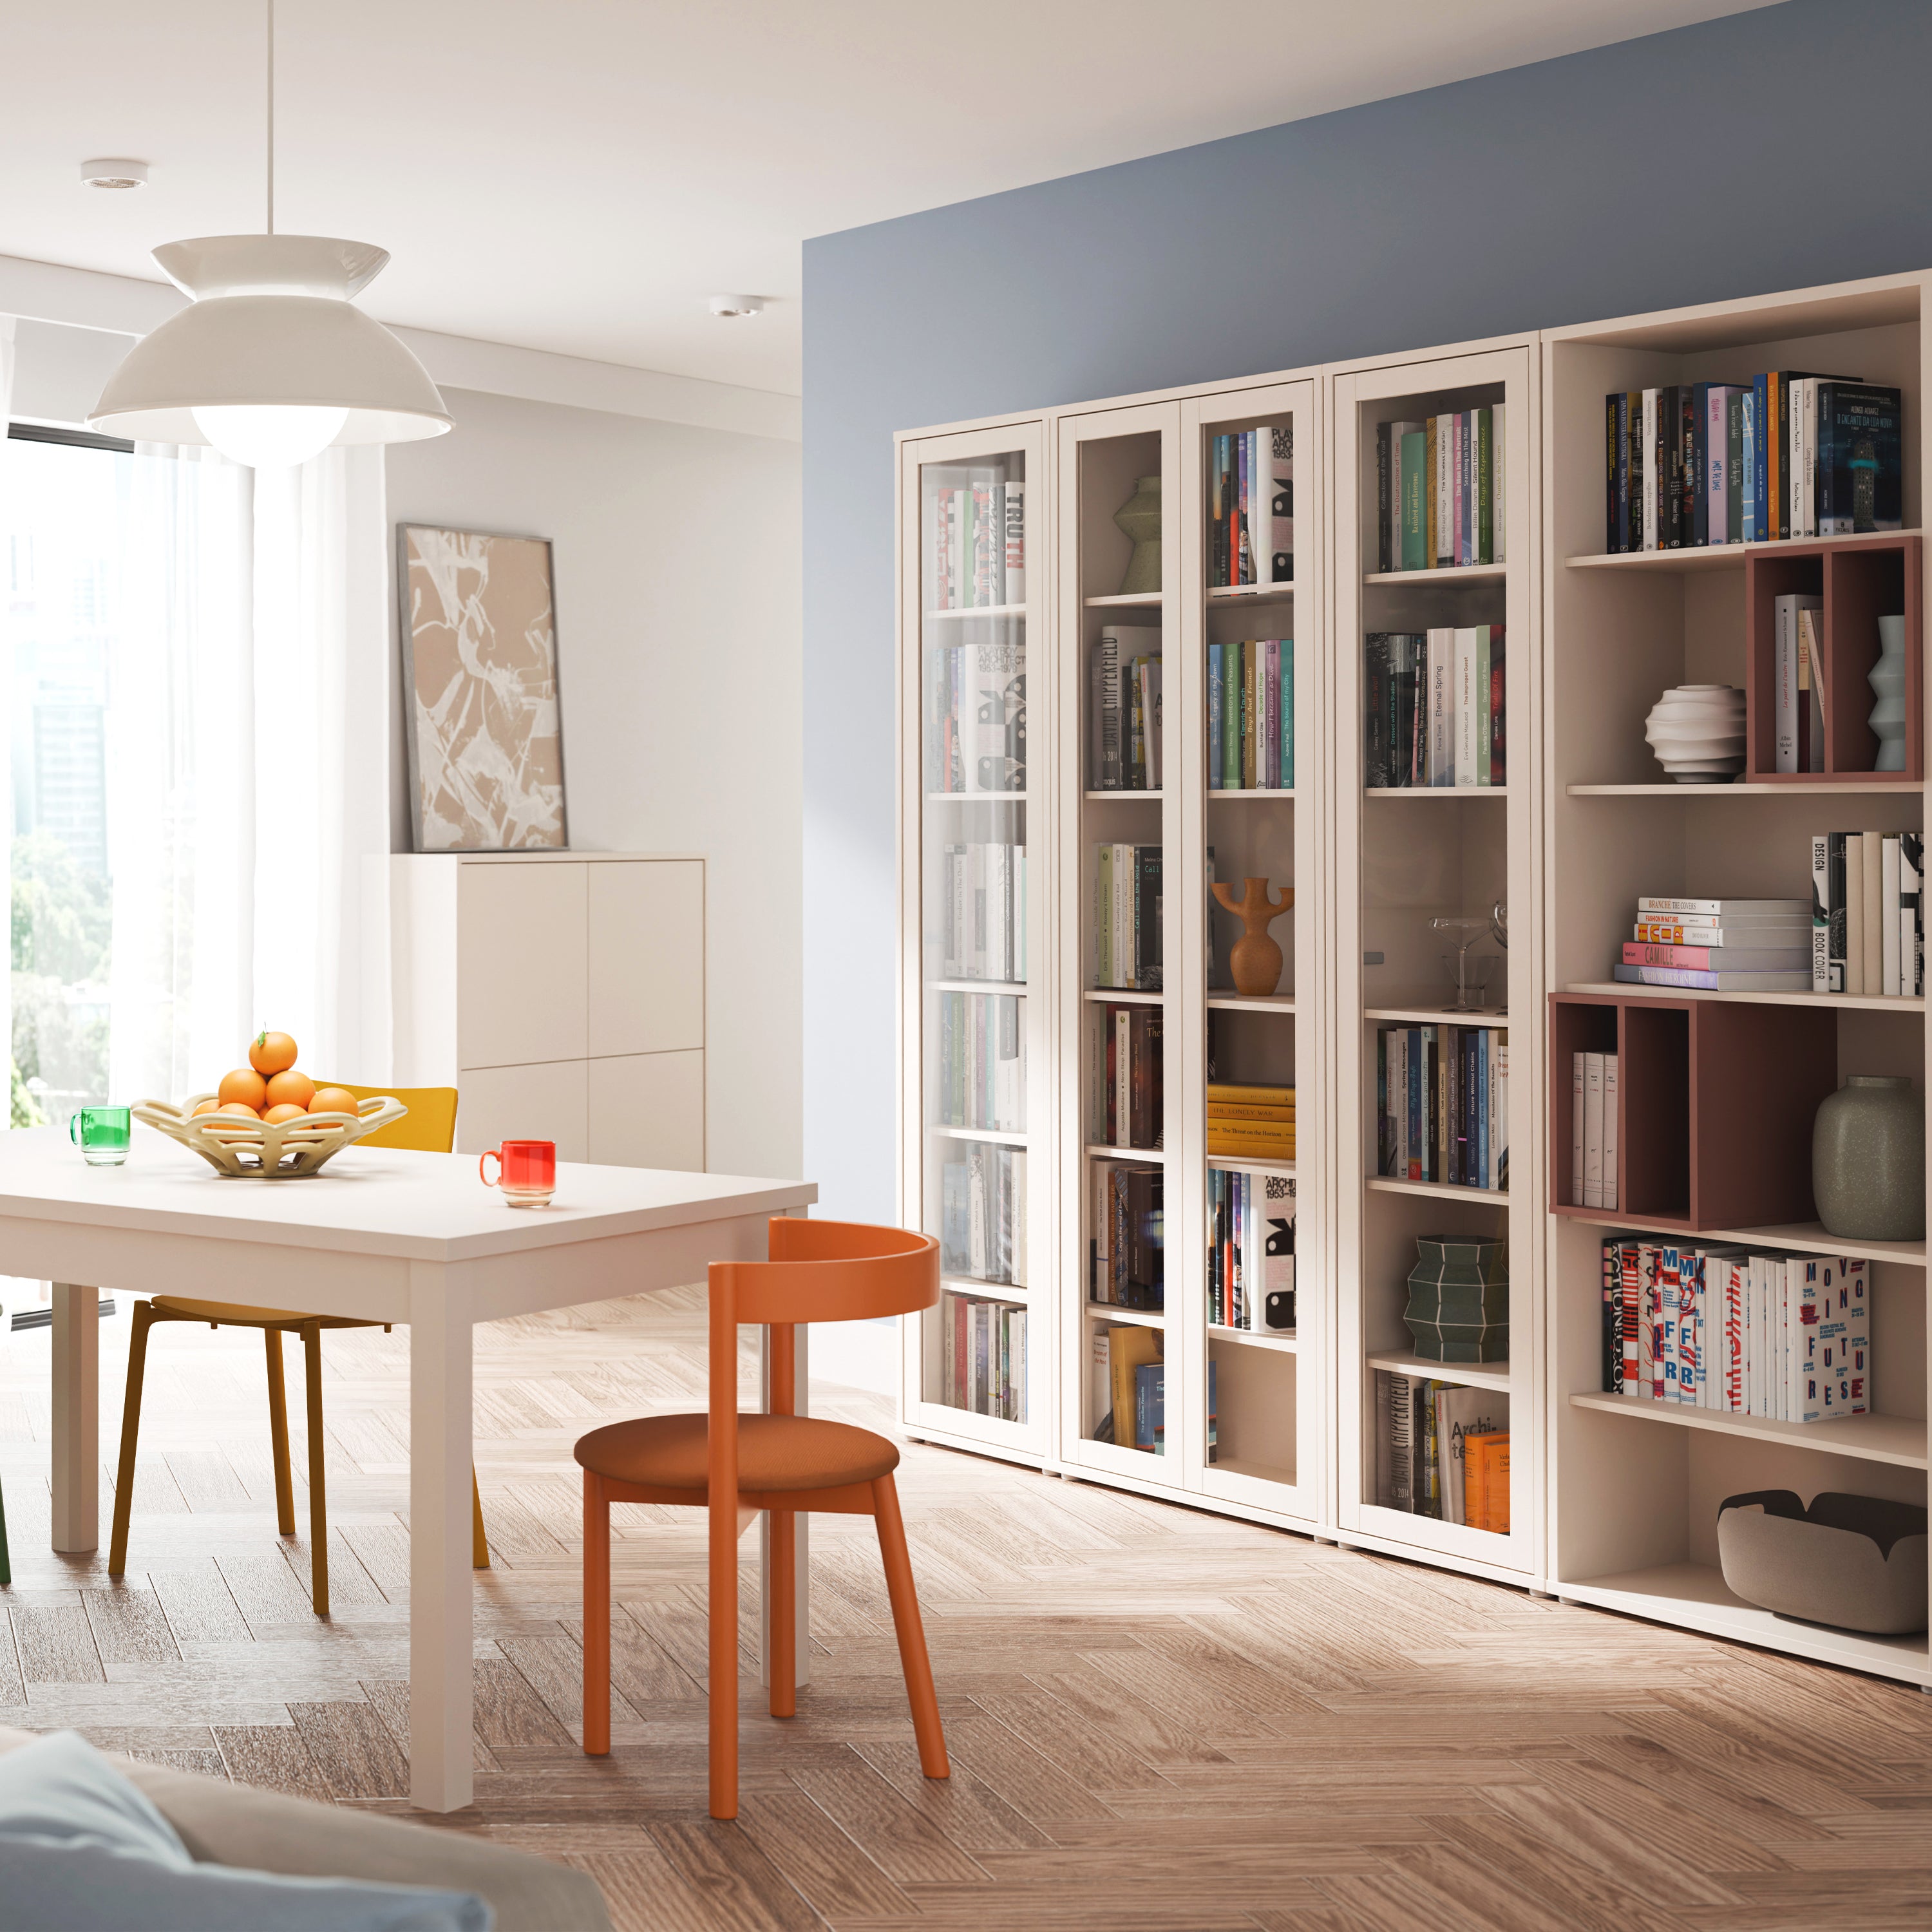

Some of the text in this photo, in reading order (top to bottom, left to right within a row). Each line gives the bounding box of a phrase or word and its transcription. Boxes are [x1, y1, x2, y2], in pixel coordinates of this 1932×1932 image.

[1842, 414, 1862, 426] ENCANTO
[1863, 416, 1870, 426] DA
[1871, 417, 1879, 427] LUA
[1880, 417, 1892, 428] NOVA
[1480, 475, 1486, 484] of
[1007, 493, 1024, 569] TRUTH
[978, 646, 1018, 655] PLAYBOY
[1103, 637, 1117, 710] CHIPPERFIELD
[1108, 752, 1117, 761] 2014
[1815, 844, 1824, 871] DESIGN
[1649, 899, 1671, 909] BRANCHÉ
[1645, 946, 1673, 965] CAMILLE
[1815, 933, 1825, 980] BOOK COVER
[1147, 1027, 1160, 1037] The
[1227, 1108, 1256, 1116] LONELY
[1257, 1108, 1273, 1116] WAR
[1222, 1128, 1231, 1137] The
[1231, 1128, 1245, 1137] Threat
[1247, 1128, 1253, 1137] on
[1262, 1128, 1282, 1137] Horizon
[1391, 1377, 1408, 1449] CHIPPERFIELD
[1398, 1488, 1408, 1498] 2014
